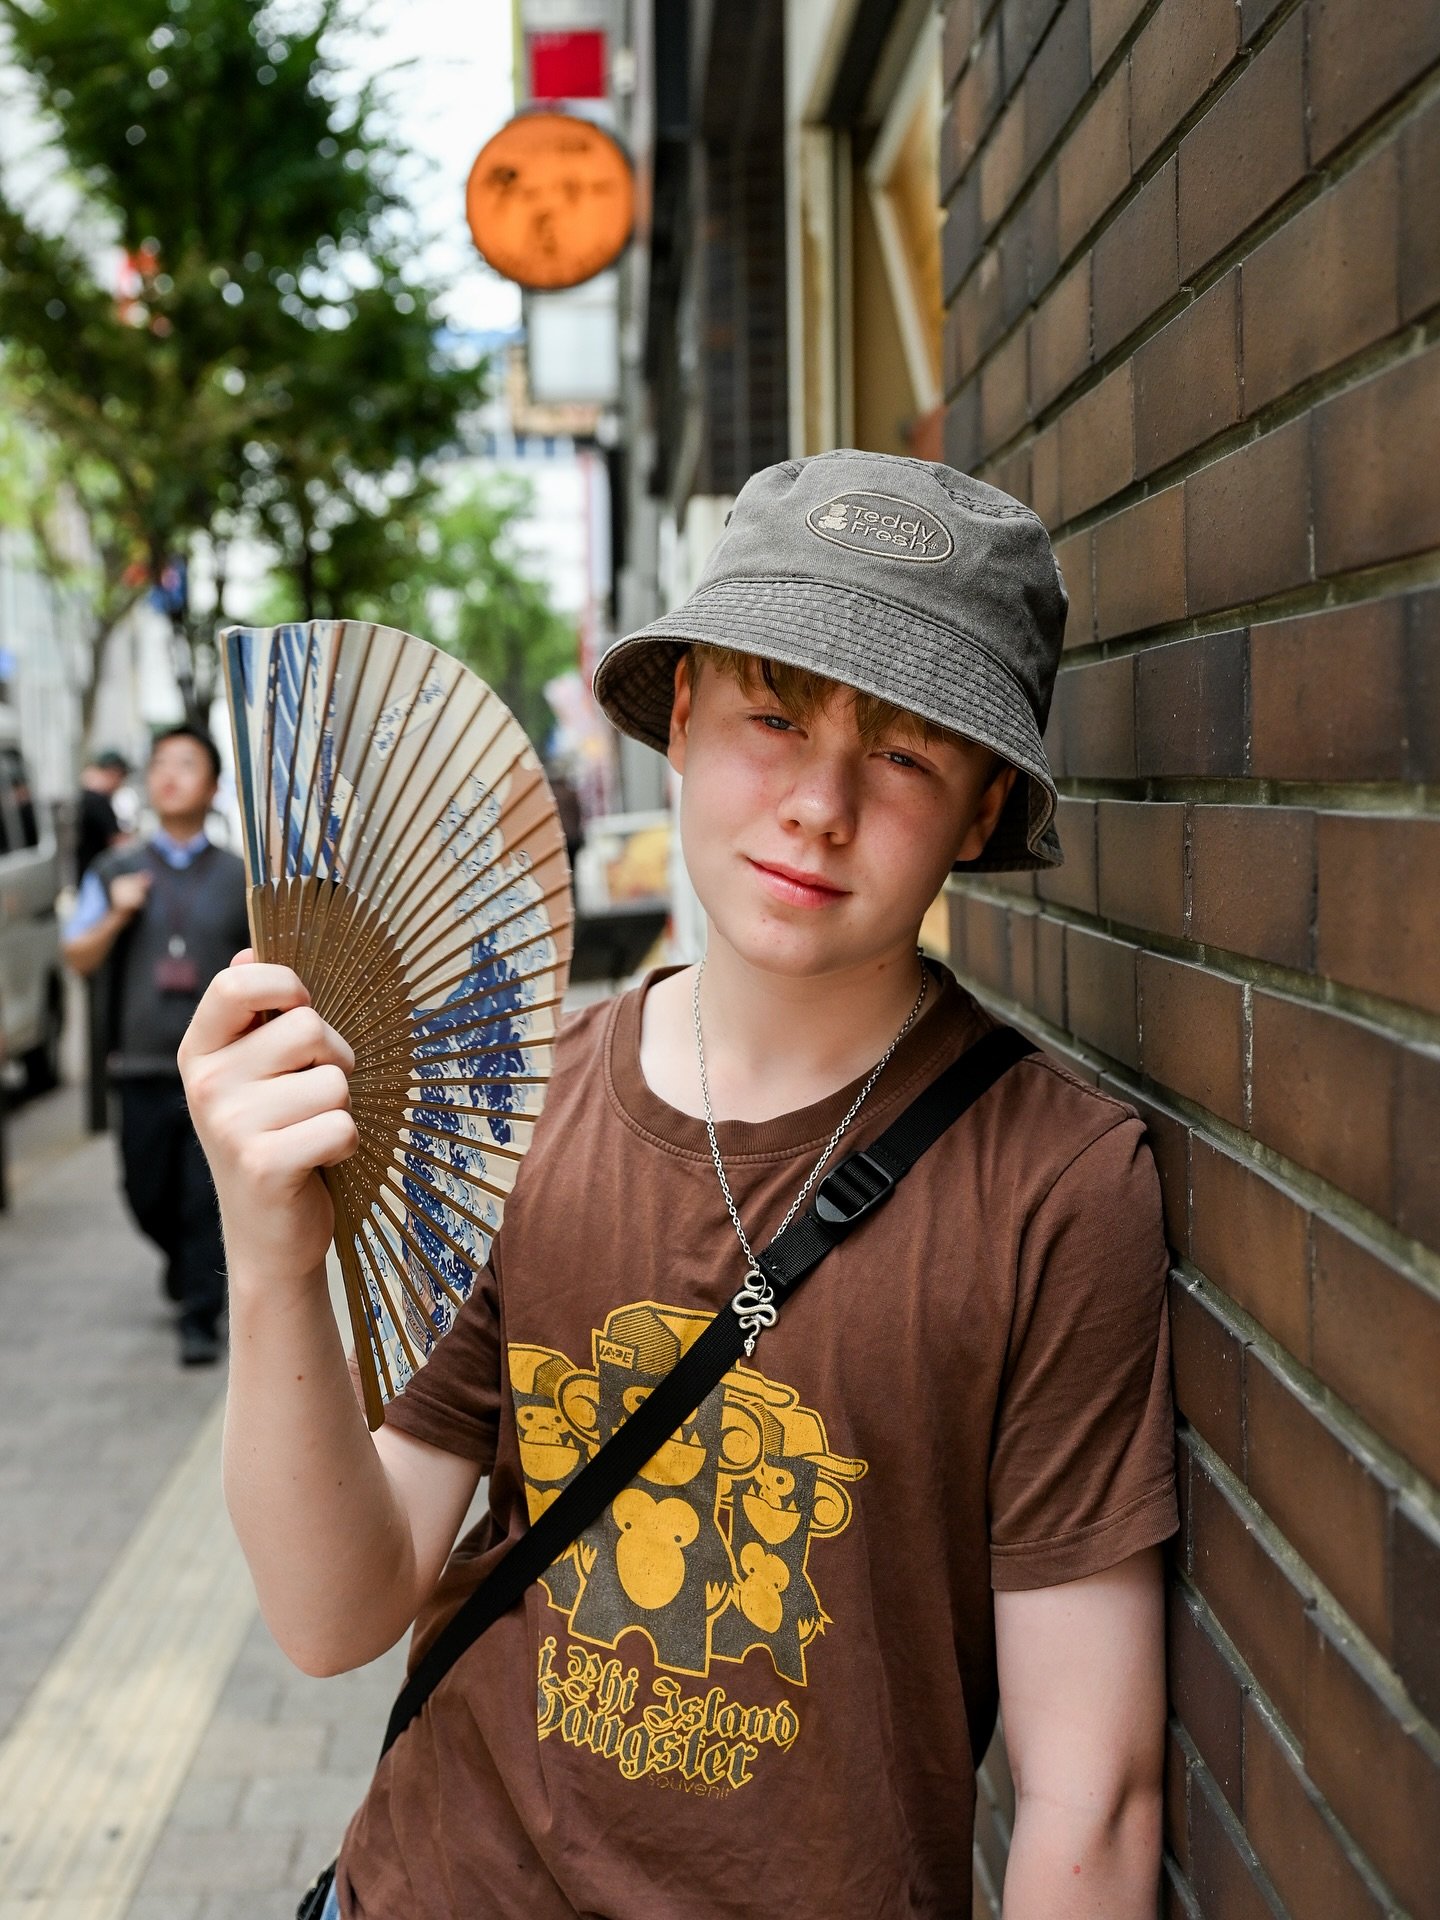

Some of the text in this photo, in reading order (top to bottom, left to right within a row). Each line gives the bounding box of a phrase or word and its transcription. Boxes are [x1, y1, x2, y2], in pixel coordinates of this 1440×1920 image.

[851, 521, 928, 554] Fresh
[852, 505, 937, 543] Teddy
[642, 1676, 800, 1750] Island
[647, 1772, 732, 1800] souvenir
